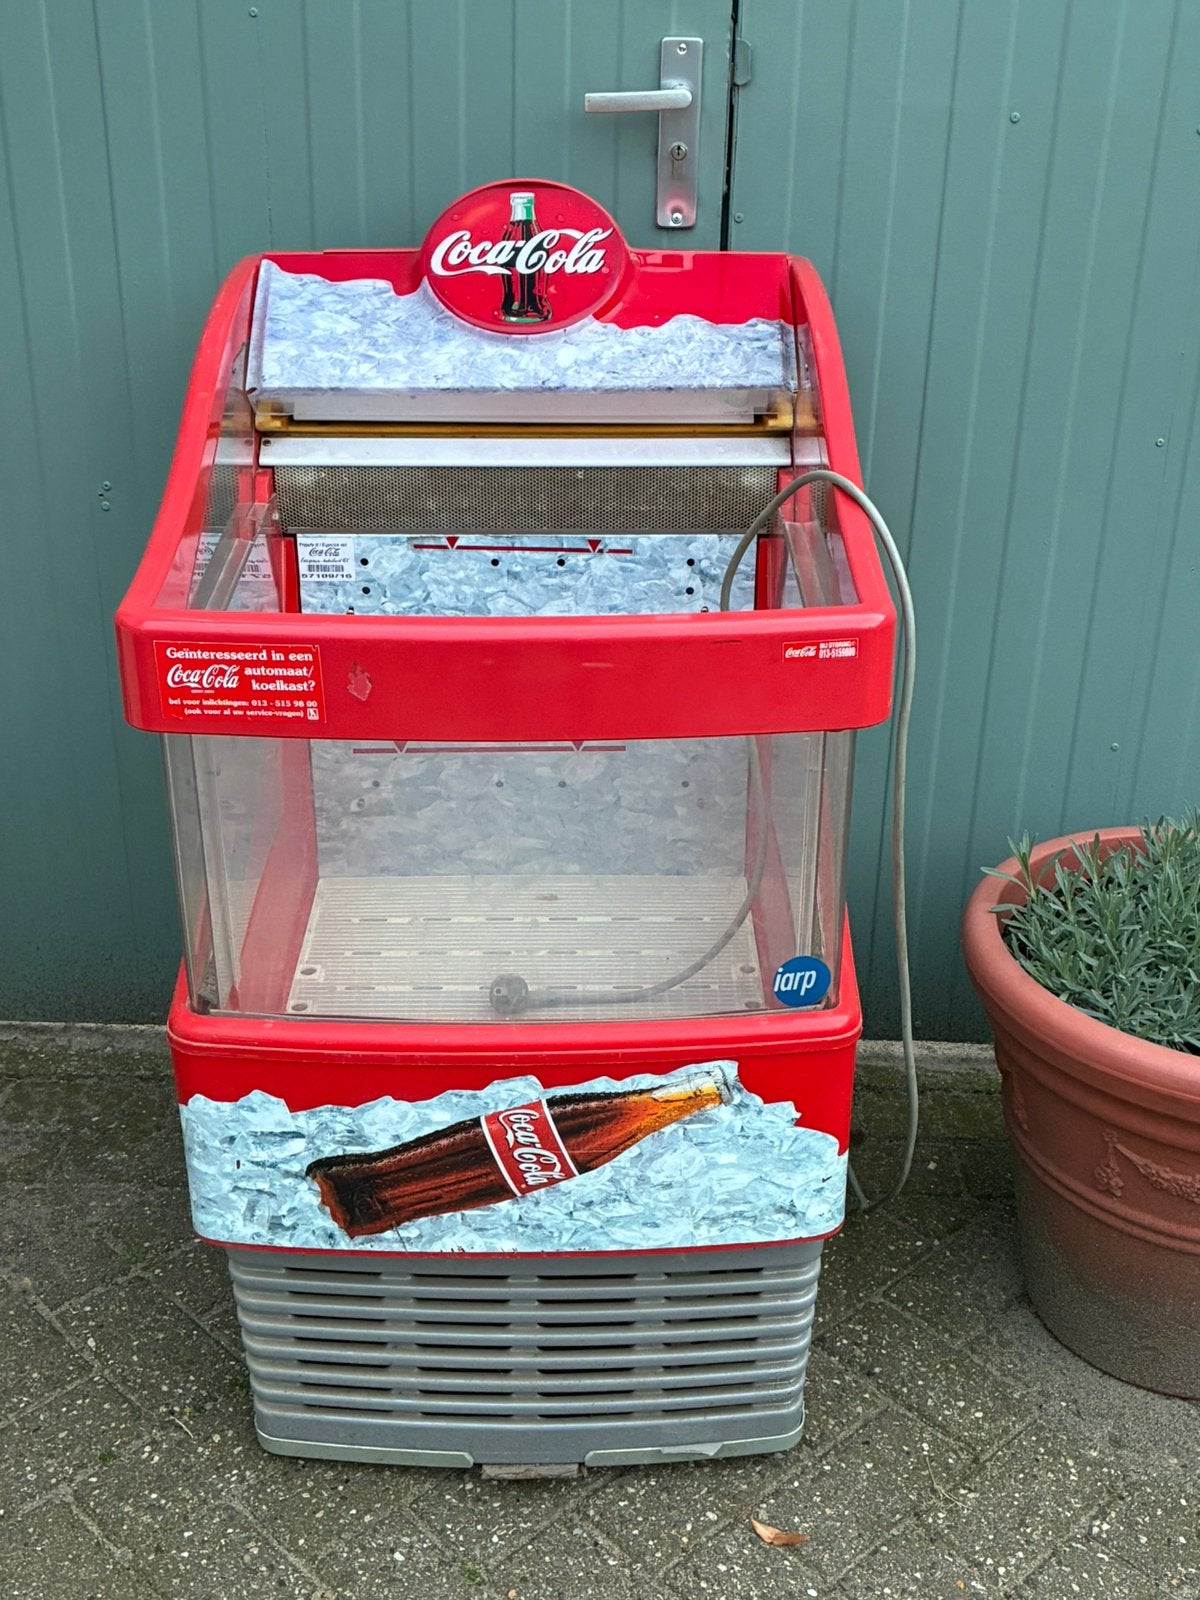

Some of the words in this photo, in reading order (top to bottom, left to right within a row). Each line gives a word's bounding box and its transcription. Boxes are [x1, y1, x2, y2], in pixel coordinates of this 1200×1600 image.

[430, 227, 614, 276] Coca-Cola
[308, 547, 341, 557] Coca-Cola
[166, 647, 267, 661] Geïnteresseerd
[271, 650, 285, 661] in
[288, 652, 313, 661] een
[785, 645, 817, 659] Coca-Cola
[166, 663, 240, 689] Coca-Cola
[244, 665, 314, 678] automaat/
[251, 679, 316, 692] koelkast?
[168, 697, 181, 705] bel
[182, 698, 200, 706] voor
[275, 700, 292, 708] 515
[293, 700, 305, 708] 98
[306, 700, 318, 708] 00
[184, 707, 201, 716] (ook
[203, 708, 221, 716] voor
[246, 709, 304, 719] service-vragen)
[774, 967, 817, 996] iarp
[498, 1108, 566, 1186] Coca-Cola
